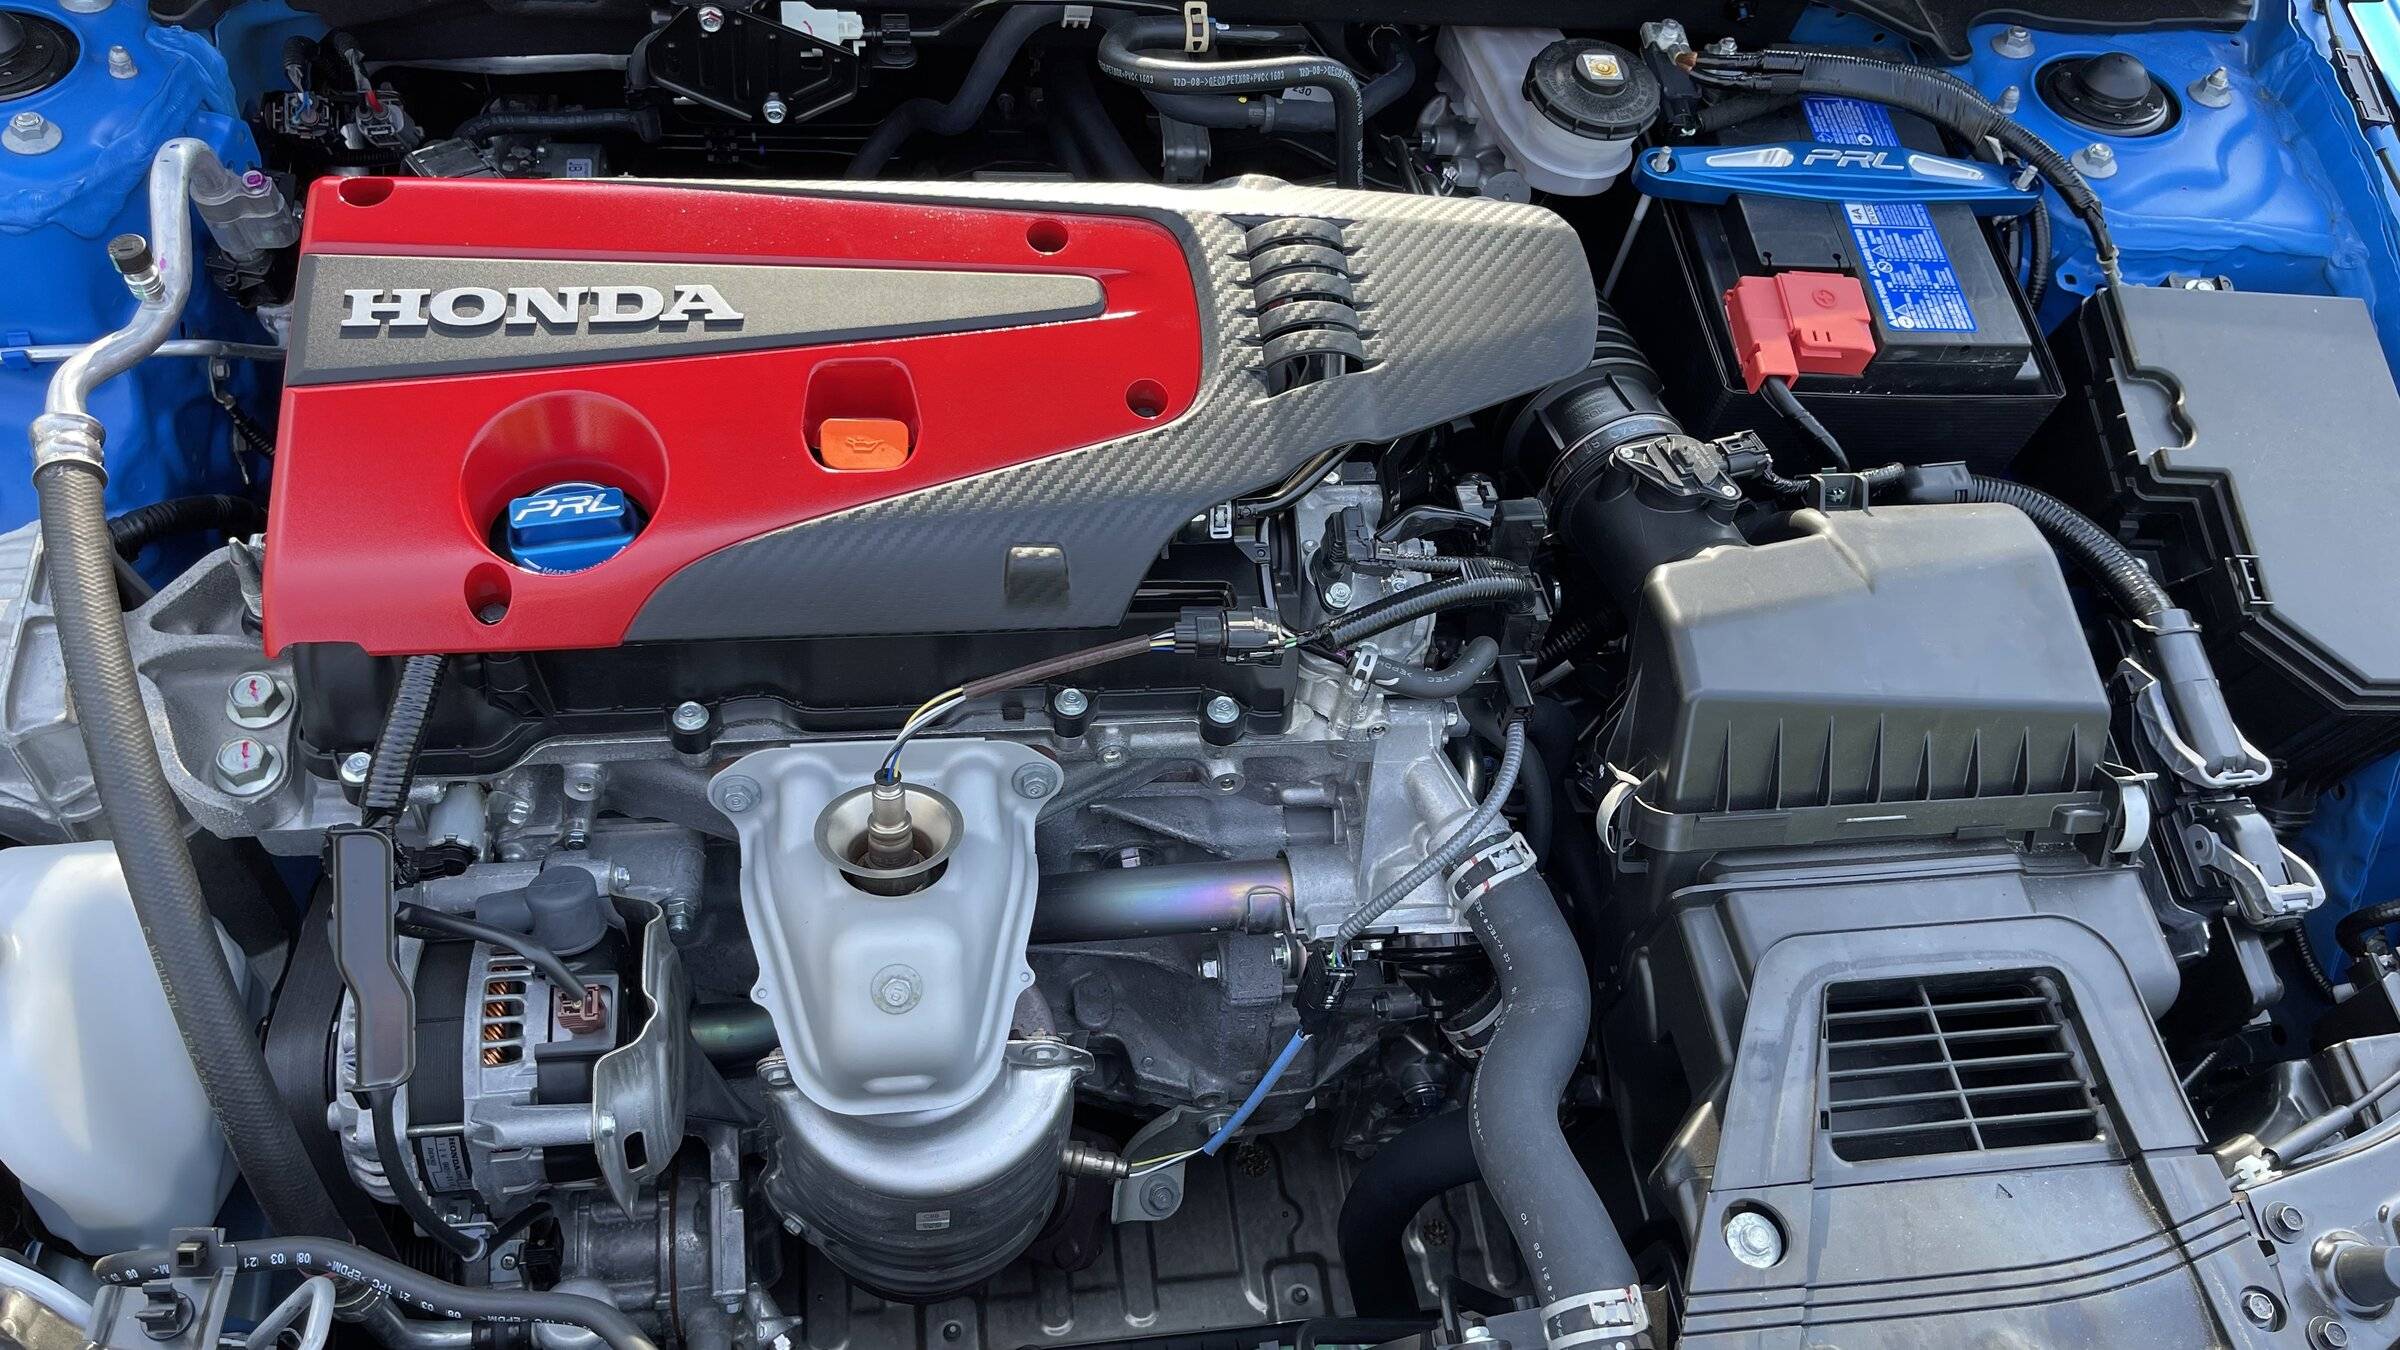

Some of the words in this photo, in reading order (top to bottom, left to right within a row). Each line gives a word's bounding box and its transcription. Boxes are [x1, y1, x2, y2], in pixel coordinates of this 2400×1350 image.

[1803, 148, 1904, 170] PRL
[341, 284, 744, 328] HONDA
[514, 493, 620, 521] PRL
[1427, 670, 1464, 683] Y-TEC
[1486, 924, 1504, 950] Y-TEC
[1520, 1212, 1529, 1226] 10
[1533, 1242, 1543, 1259] 08
[244, 1256, 256, 1268] 21
[1541, 1266, 1550, 1281] 21
[372, 1278, 393, 1298] TPC
[398, 1290, 410, 1302] 21
